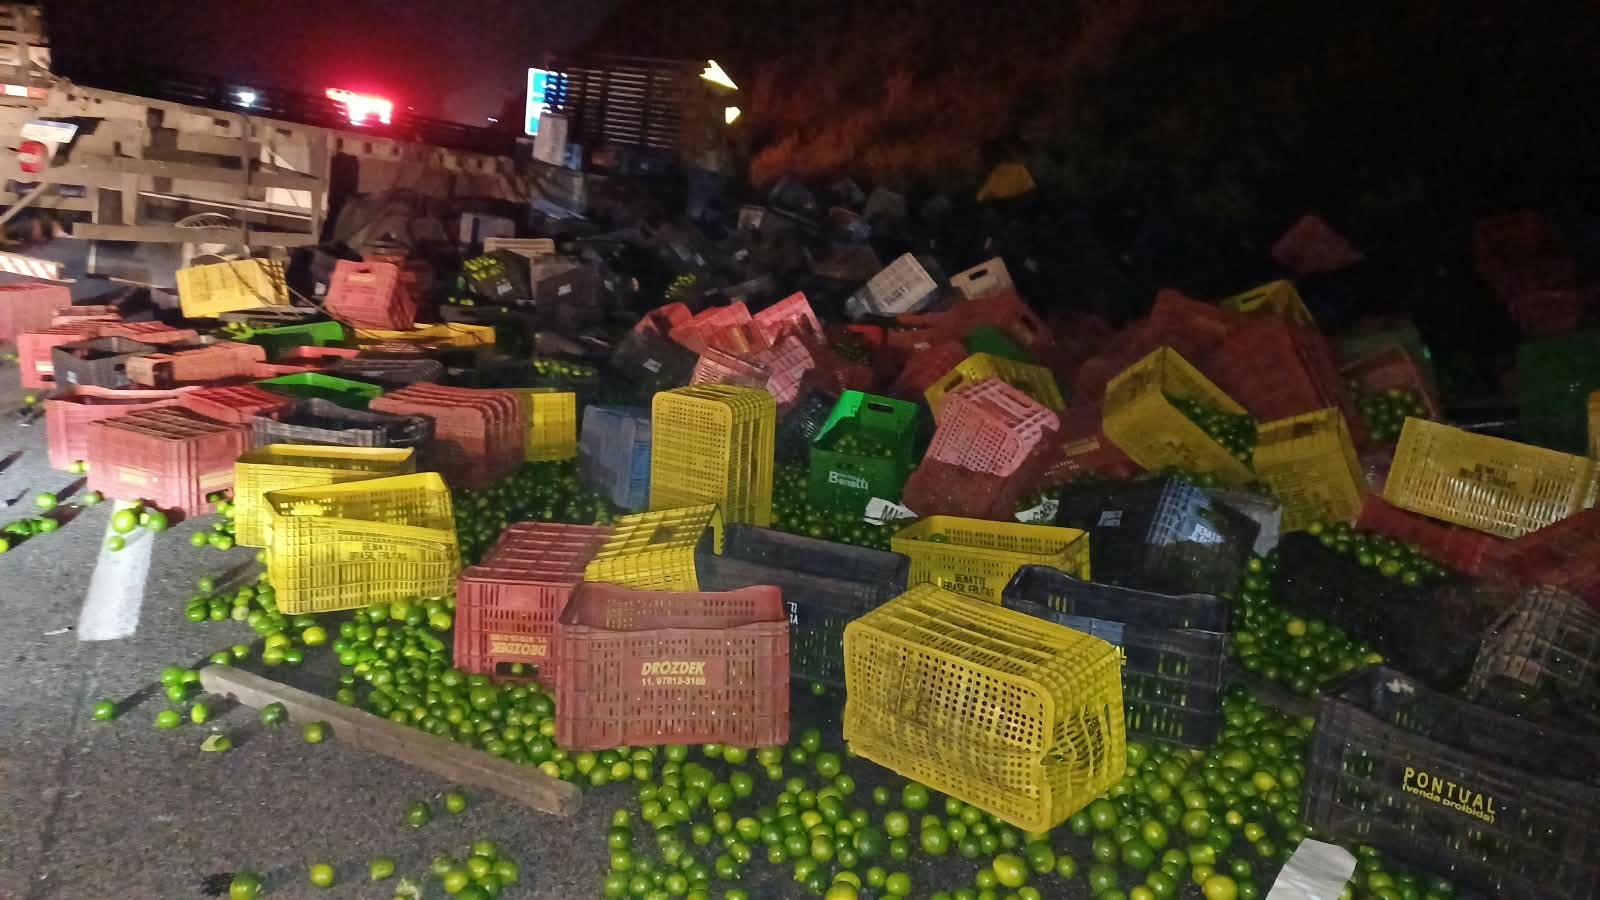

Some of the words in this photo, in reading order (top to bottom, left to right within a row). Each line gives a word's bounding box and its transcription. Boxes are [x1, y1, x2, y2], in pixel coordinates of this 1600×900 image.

[641, 660, 706, 676] DROZDEK
[1402, 783, 1441, 803] (venda
[1403, 767, 1496, 815] PONTUAL
